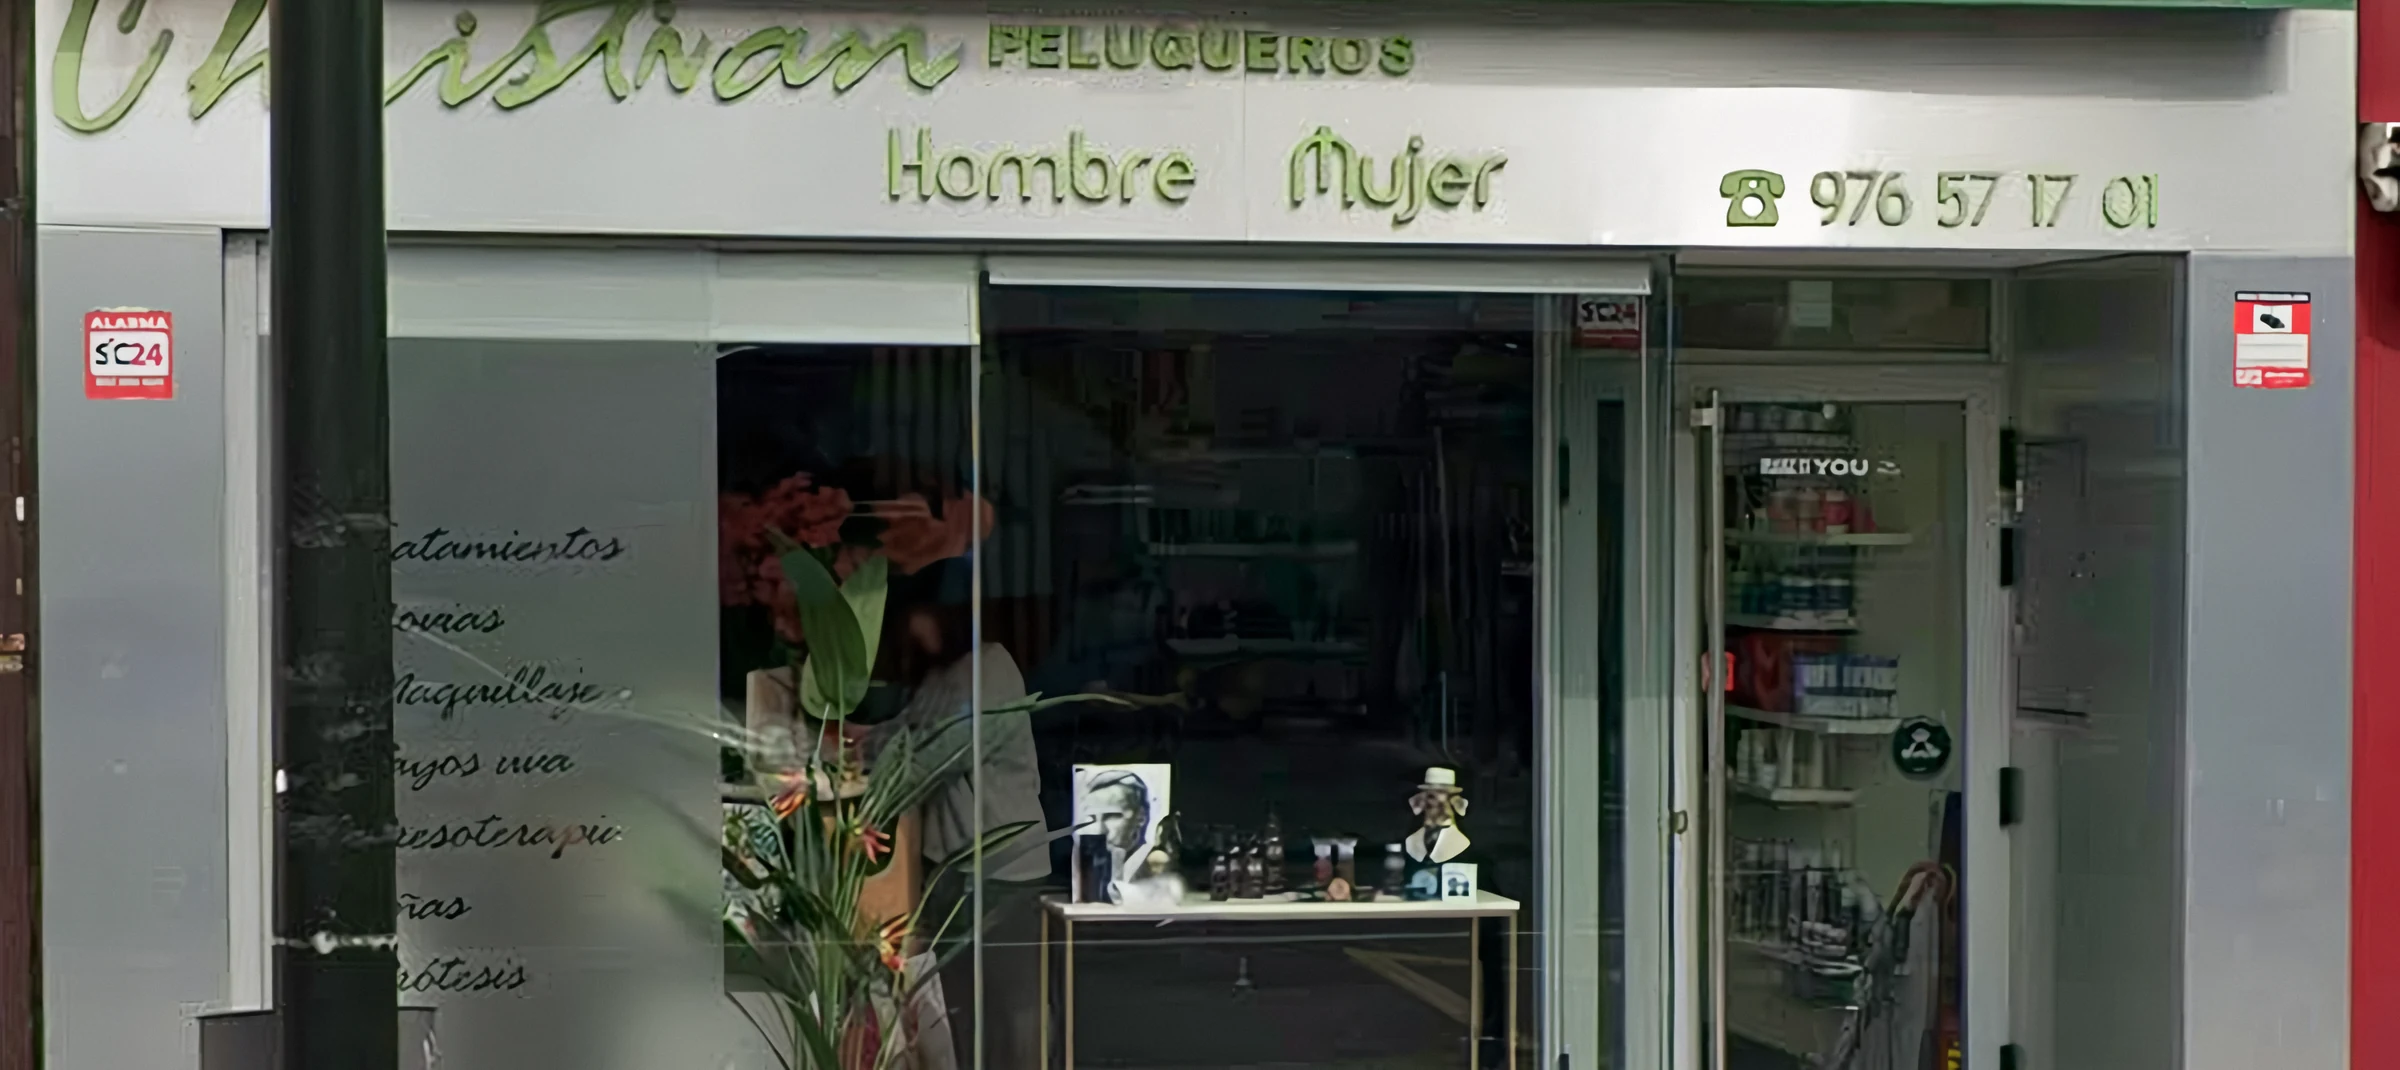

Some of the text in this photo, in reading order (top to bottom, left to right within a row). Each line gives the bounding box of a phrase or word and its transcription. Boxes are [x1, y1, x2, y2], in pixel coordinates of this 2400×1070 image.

[53, 0, 1416, 134] Chistian PELUQUEROS
[886, 125, 1509, 227] Hombre Mujer
[1809, 170, 2160, 230] 976 57 17 01
[390, 526, 625, 562] atamientos
[391, 603, 505, 634] ovias
[397, 893, 473, 921] ñas
[397, 956, 527, 993] rótesis
